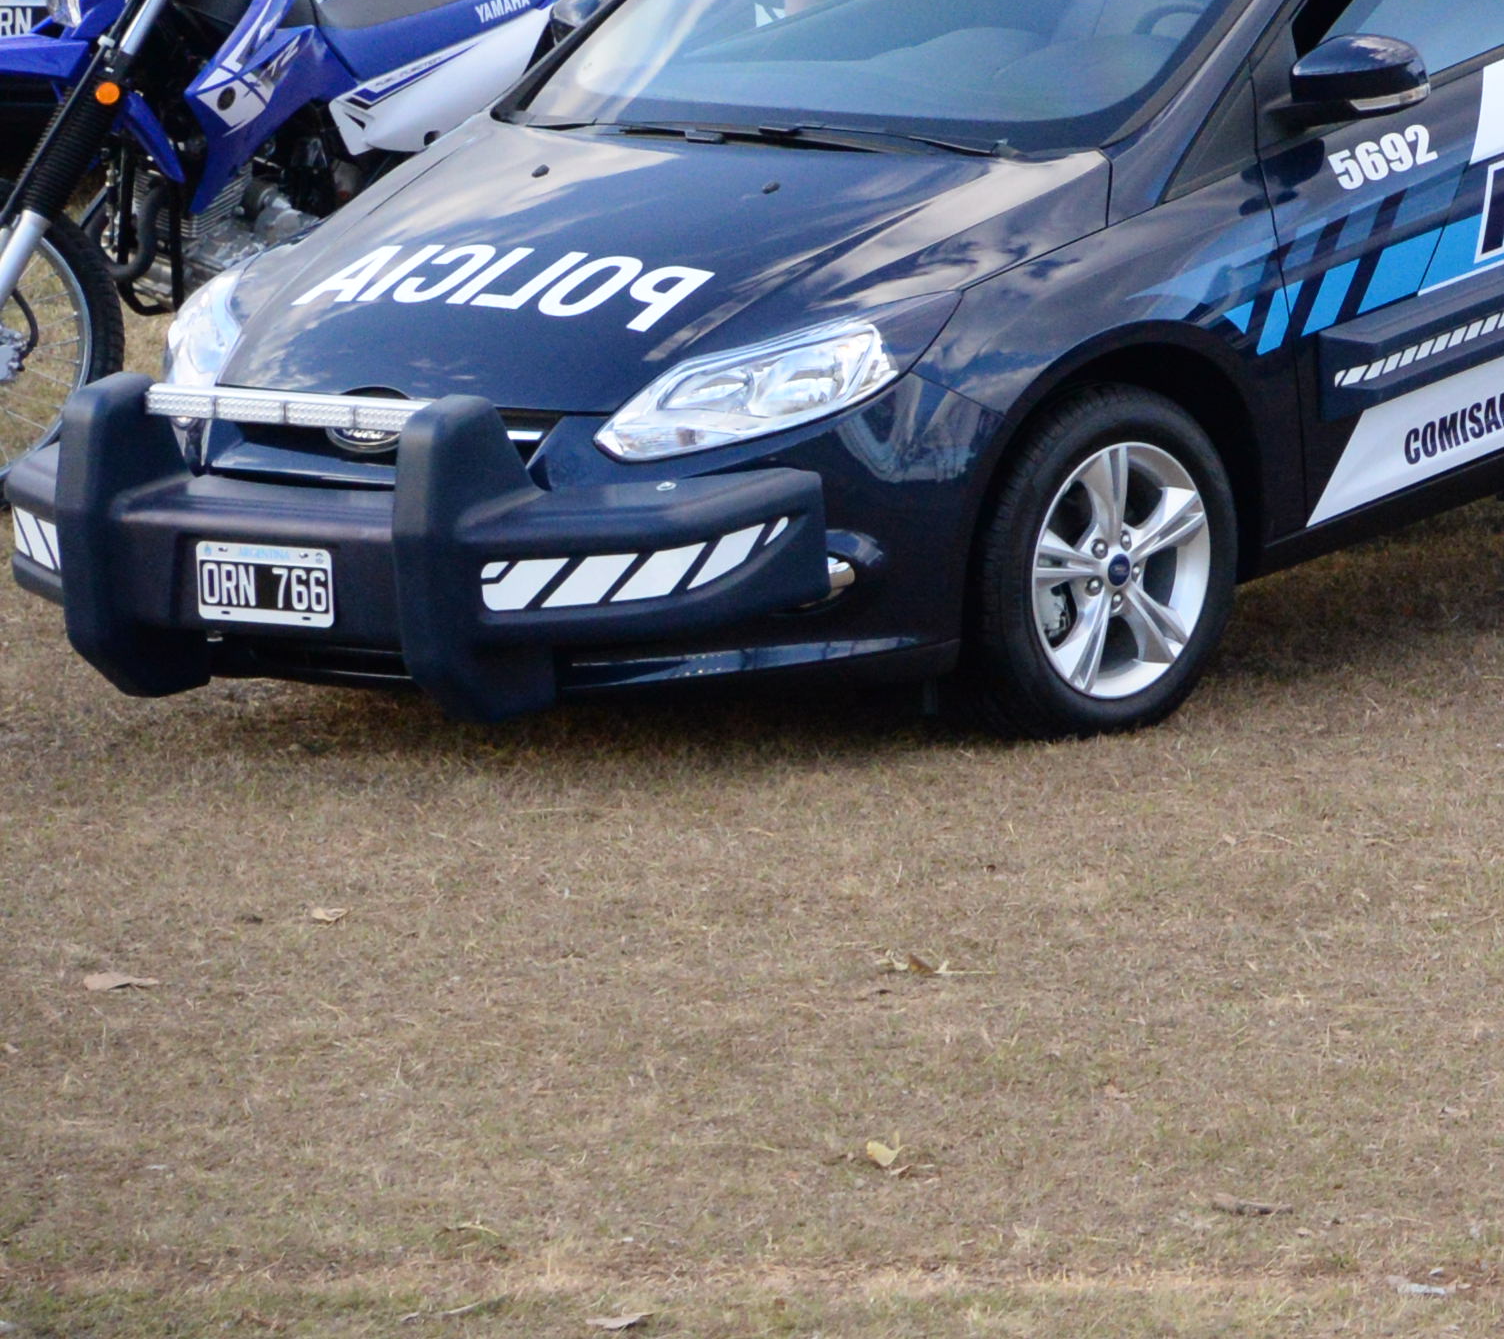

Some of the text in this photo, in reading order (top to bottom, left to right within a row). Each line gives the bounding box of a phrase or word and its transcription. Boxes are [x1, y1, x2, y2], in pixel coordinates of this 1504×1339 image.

[0, 7, 32, 36] RN
[1327, 124, 1439, 191] 5692
[202, 561, 327, 612] ORN 766
